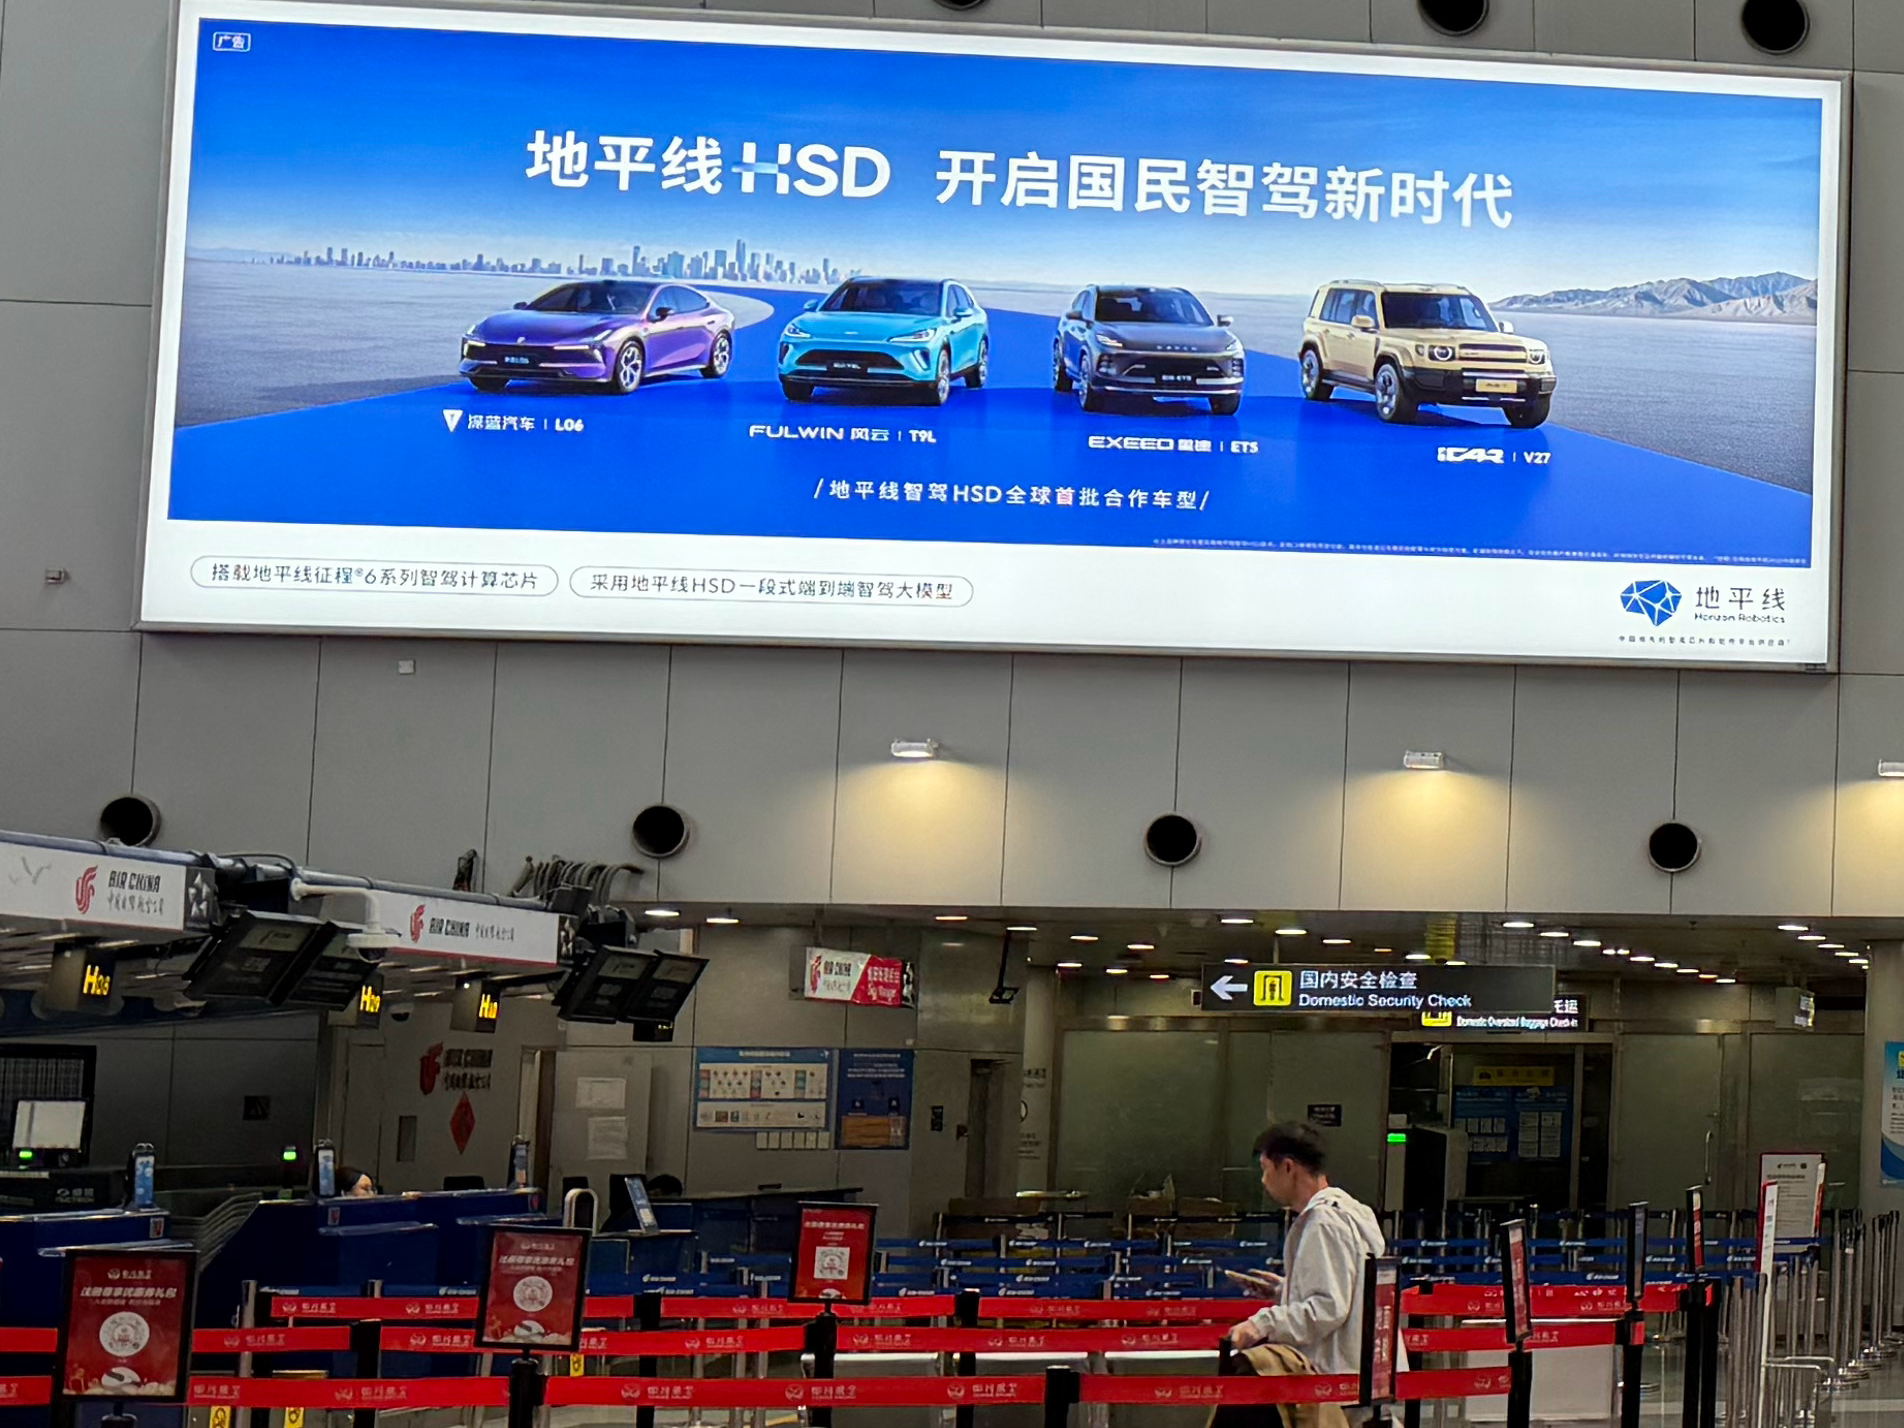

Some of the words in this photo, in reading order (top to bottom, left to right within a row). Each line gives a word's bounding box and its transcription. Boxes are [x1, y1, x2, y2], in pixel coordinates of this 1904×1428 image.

[935, 150, 1513, 228] 开启国民智驾新时代
[467, 414, 535, 432] 深蓝汽车
[554, 418, 584, 433] L06
[749, 425, 844, 440] FULWIN
[850, 428, 889, 442] 风云
[1523, 452, 1551, 464] V27
[1695, 586, 1785, 611] 地平线
[108, 871, 126, 891] AIR
[128, 873, 161, 893] CHINA
[1300, 970, 1418, 990] 国内安全检查
[1299, 993, 1364, 1007] Domestic
[1368, 994, 1423, 1010] Security
[1428, 994, 1472, 1008] Check
